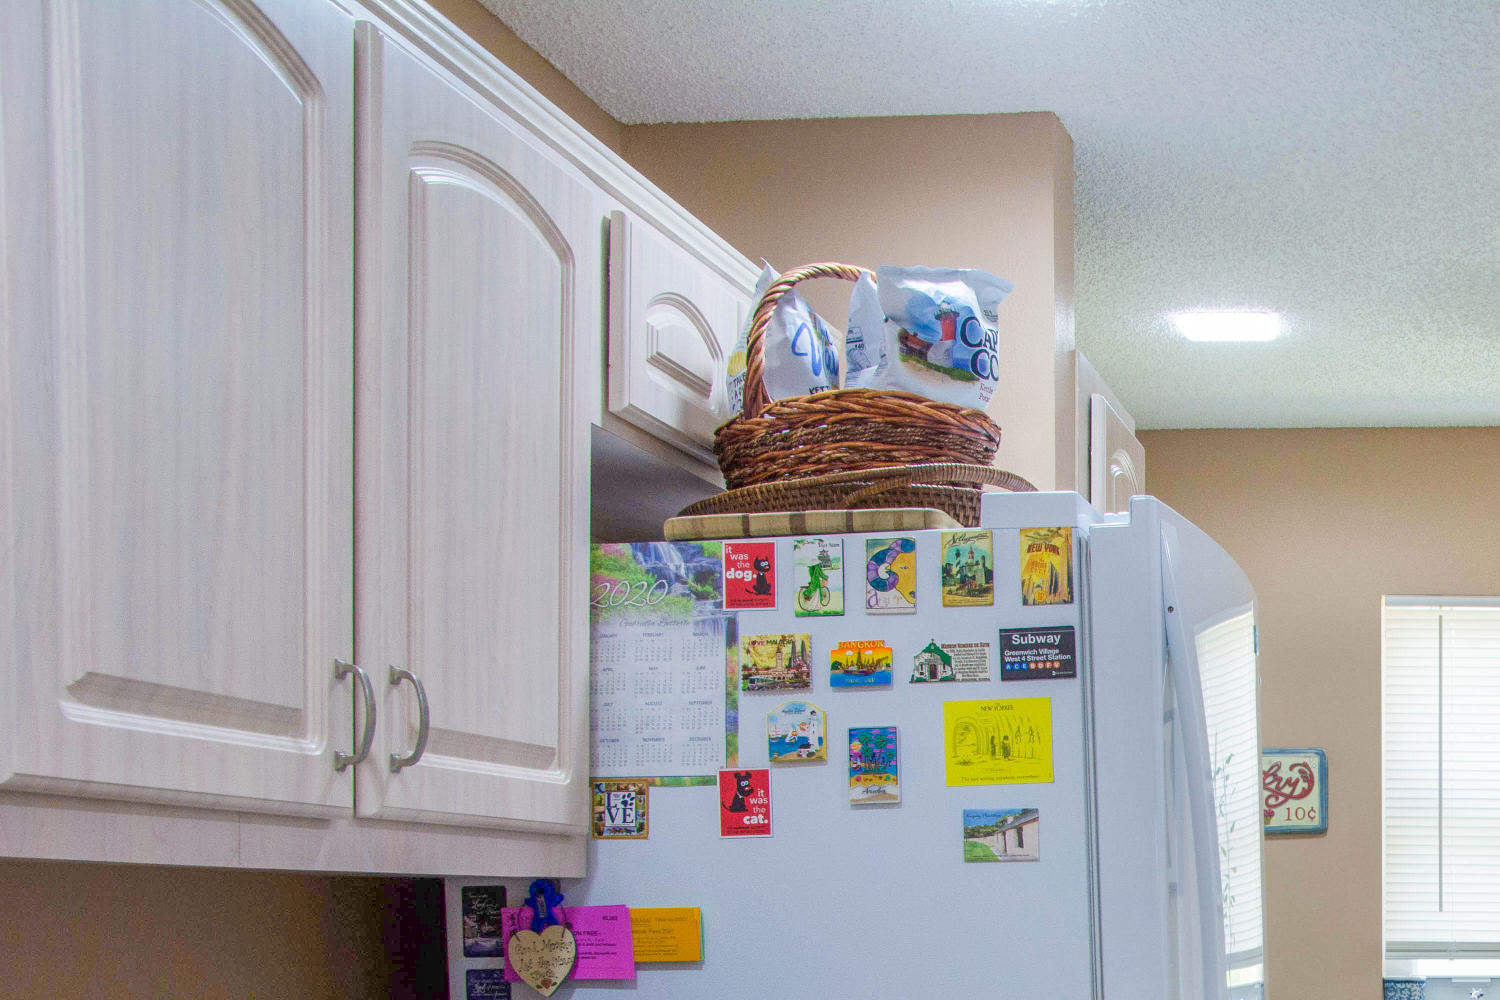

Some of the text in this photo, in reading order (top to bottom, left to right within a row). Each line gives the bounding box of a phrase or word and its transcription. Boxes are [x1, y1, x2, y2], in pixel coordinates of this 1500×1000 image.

[960, 316, 998, 353] CAP
[970, 349, 999, 381] CO
[725, 545, 732, 554] it
[737, 561, 750, 569] the
[726, 568, 757, 582] dog.
[591, 579, 669, 608] 2020
[1012, 633, 1061, 645] Subway
[757, 788, 765, 797] it
[743, 814, 769, 825] cat.
[1285, 806, 1316, 821] 10¢
